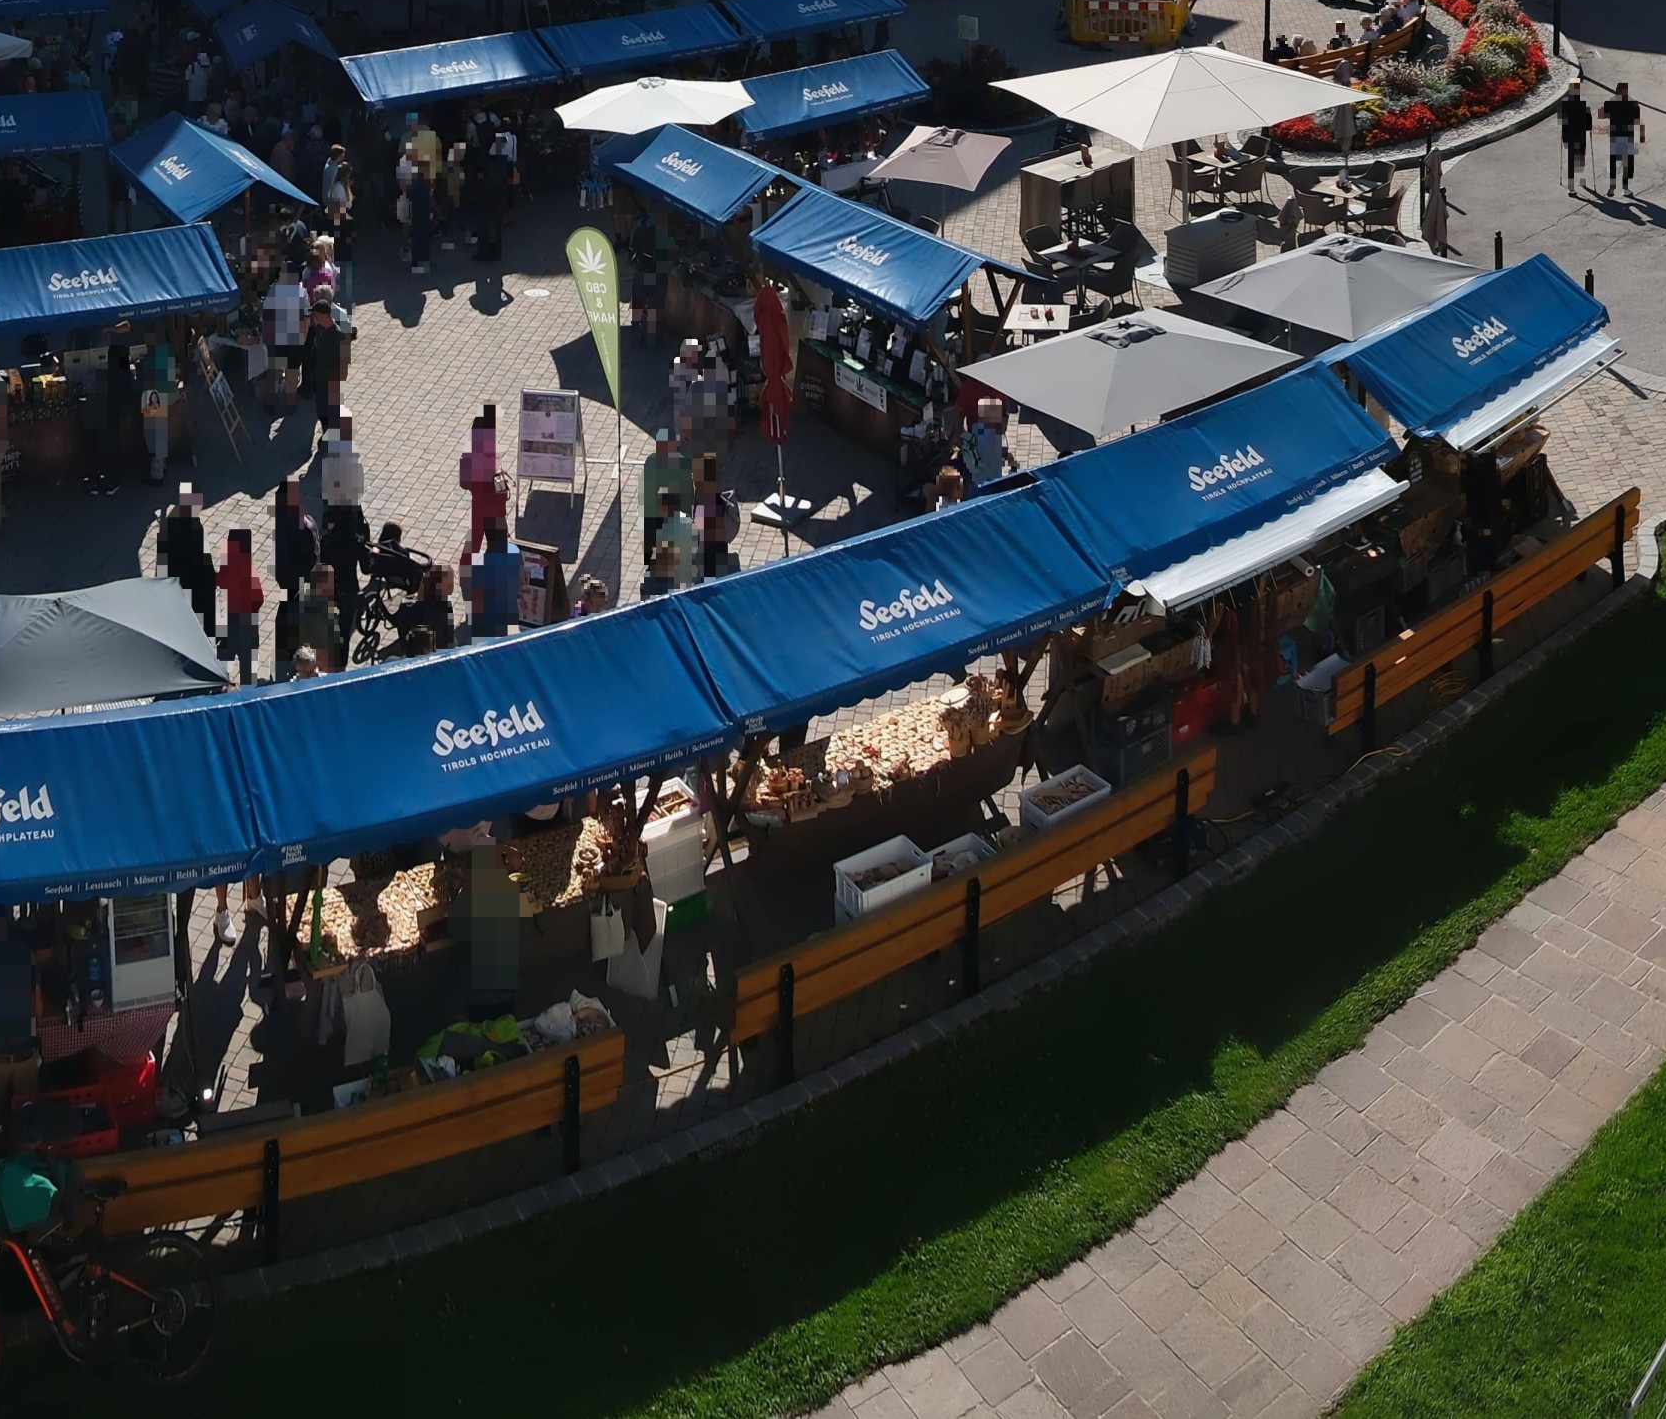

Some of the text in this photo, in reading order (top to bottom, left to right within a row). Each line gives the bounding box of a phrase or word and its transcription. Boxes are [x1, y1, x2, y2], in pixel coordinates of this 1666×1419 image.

[797, 0, 837, 14] Seefeld
[621, 31, 665, 45] Seefeld
[430, 59, 478, 75] Seefeld
[803, 81, 850, 101] Seefeld
[160, 155, 193, 180] Seefeld
[661, 151, 703, 176] Seefeld
[837, 235, 891, 267] Seefeld
[47, 266, 119, 292] Seefeld
[1452, 316, 1508, 358] Seefeld
[1188, 444, 1265, 492] Seefeld
[1201, 467, 1273, 502] TIROLS HOCHPLATEAU
[859, 579, 953, 630] Seefeld
[870, 608, 961, 644] TIROLS HOCHPLATEAU
[432, 700, 545, 756] Seefeld
[441, 738, 550, 772] TIROLS HOCHPLATEAU
[553, 736, 725, 795] Seefeld Leutasch Mösern Reith Scharnitz
[45, 884, 73, 895] Seefeld
[85, 878, 122, 891] Leutasch
[134, 873, 164, 885] Mösern
[176, 869, 198, 880] Reith
